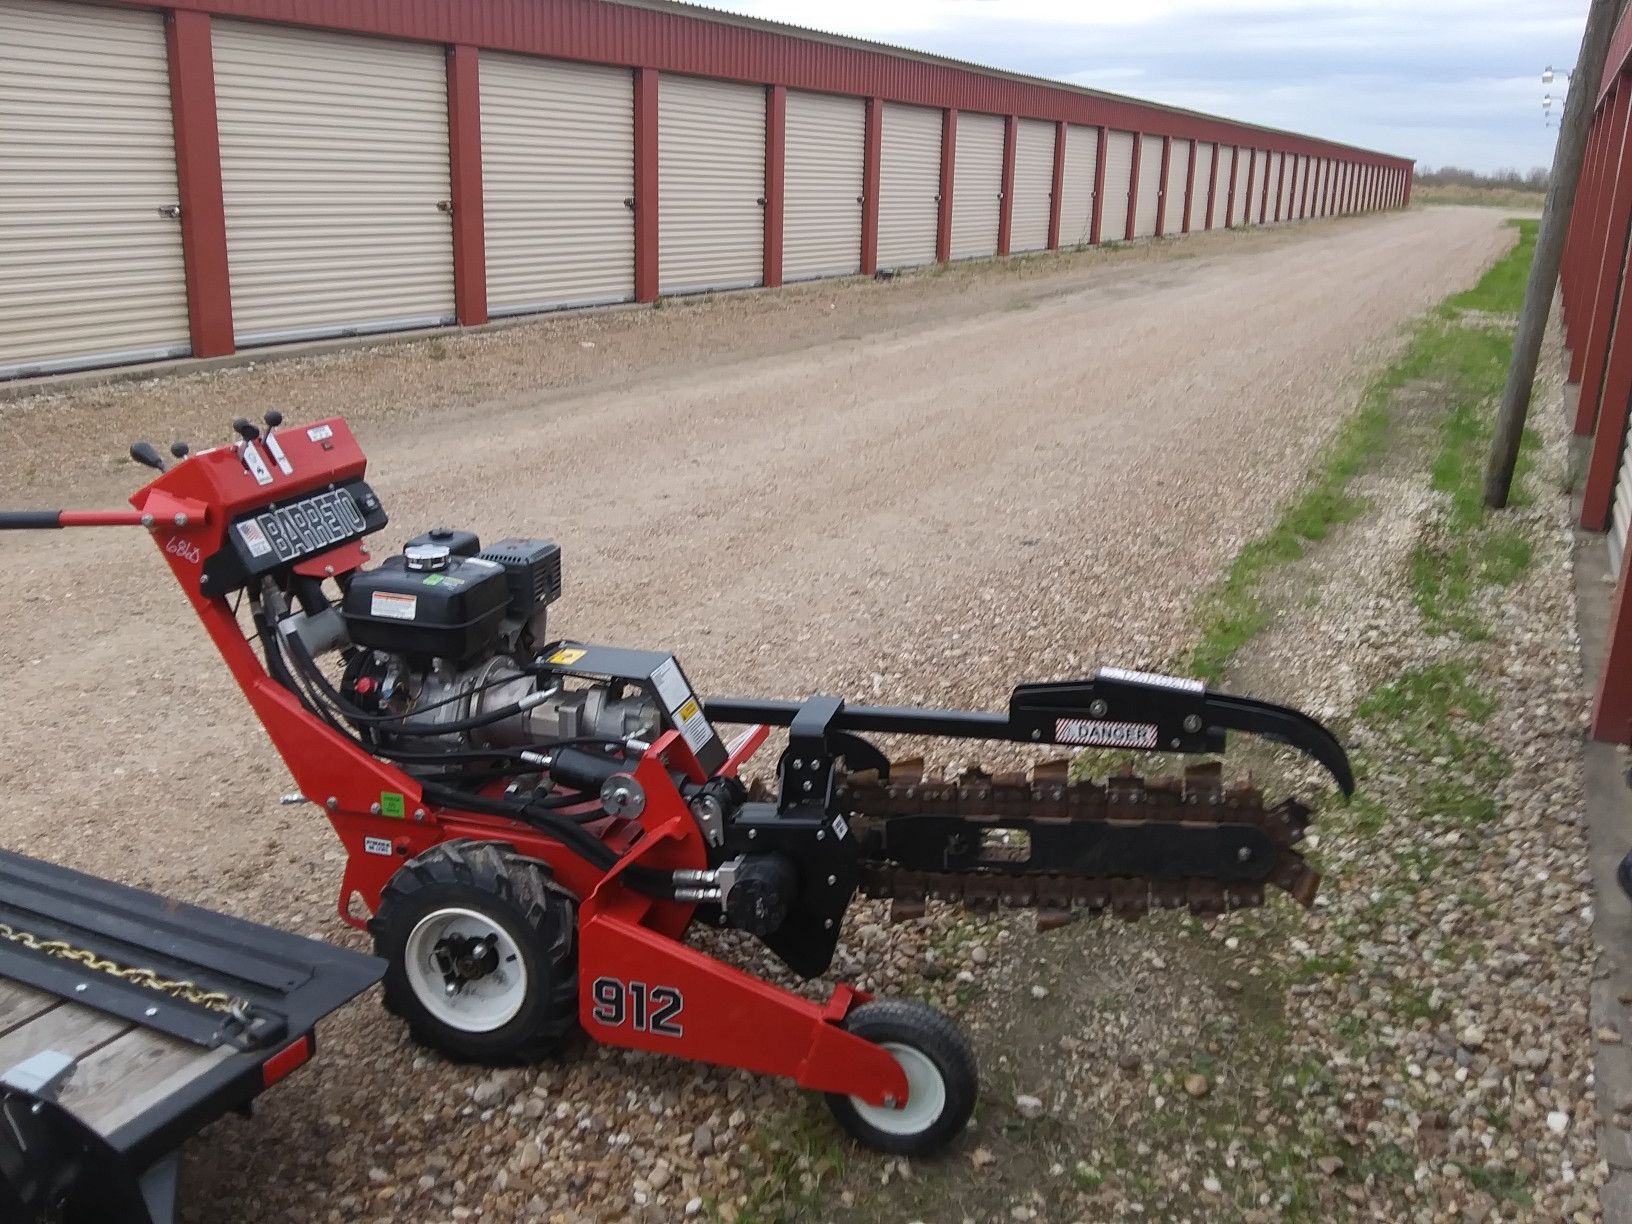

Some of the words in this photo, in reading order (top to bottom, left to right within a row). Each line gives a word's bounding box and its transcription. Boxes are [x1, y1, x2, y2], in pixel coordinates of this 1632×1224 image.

[257, 488, 366, 562] BARRETO
[1078, 725, 1148, 741] DANGER
[593, 976, 684, 1038] 912
